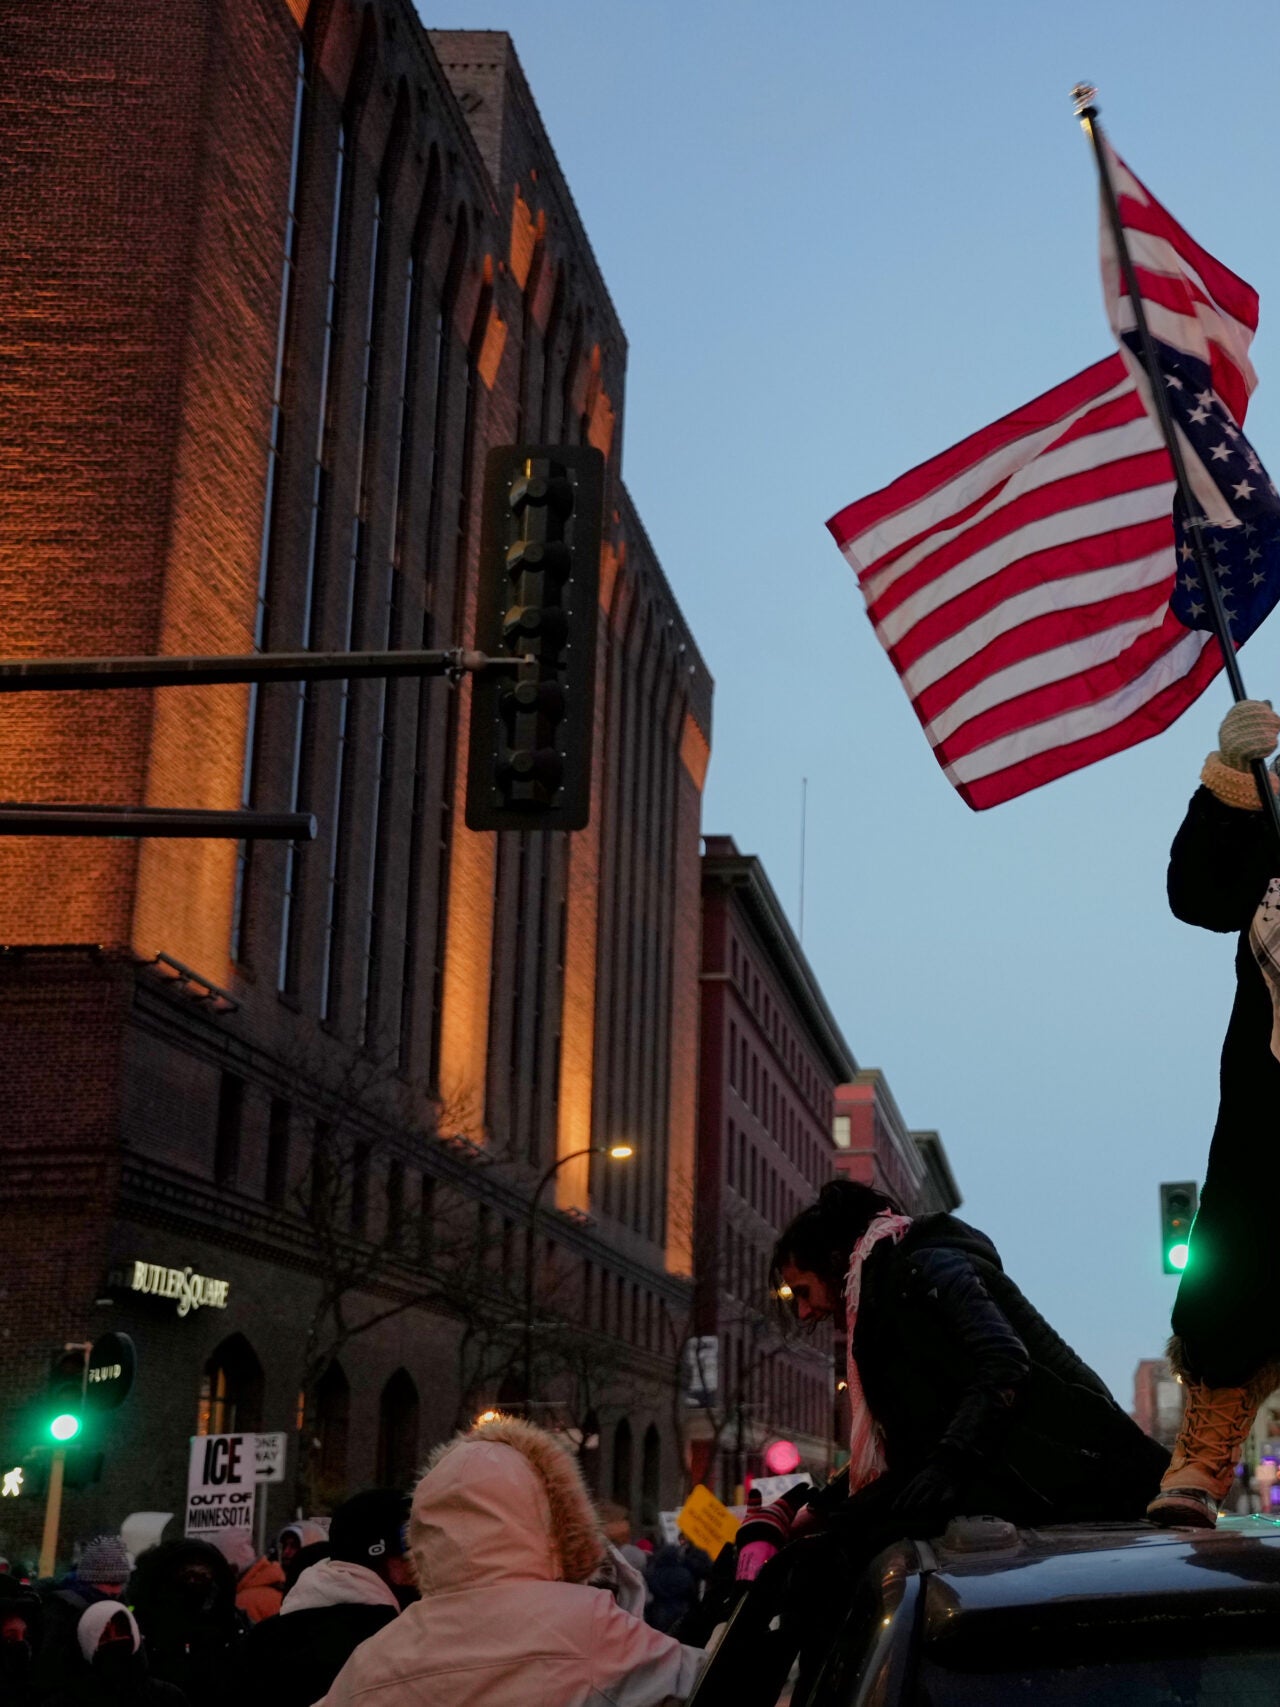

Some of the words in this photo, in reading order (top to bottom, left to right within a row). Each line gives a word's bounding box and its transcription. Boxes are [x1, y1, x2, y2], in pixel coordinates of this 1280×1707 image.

[131, 1261, 186, 1299] BUTLER
[177, 1267, 230, 1317] SQUARE
[89, 1364, 121, 1383] FLUID
[202, 1437, 243, 1486] ICE
[190, 1493, 226, 1506] OUT
[229, 1492, 253, 1504] OF
[188, 1506, 251, 1529] MINNESOTA
